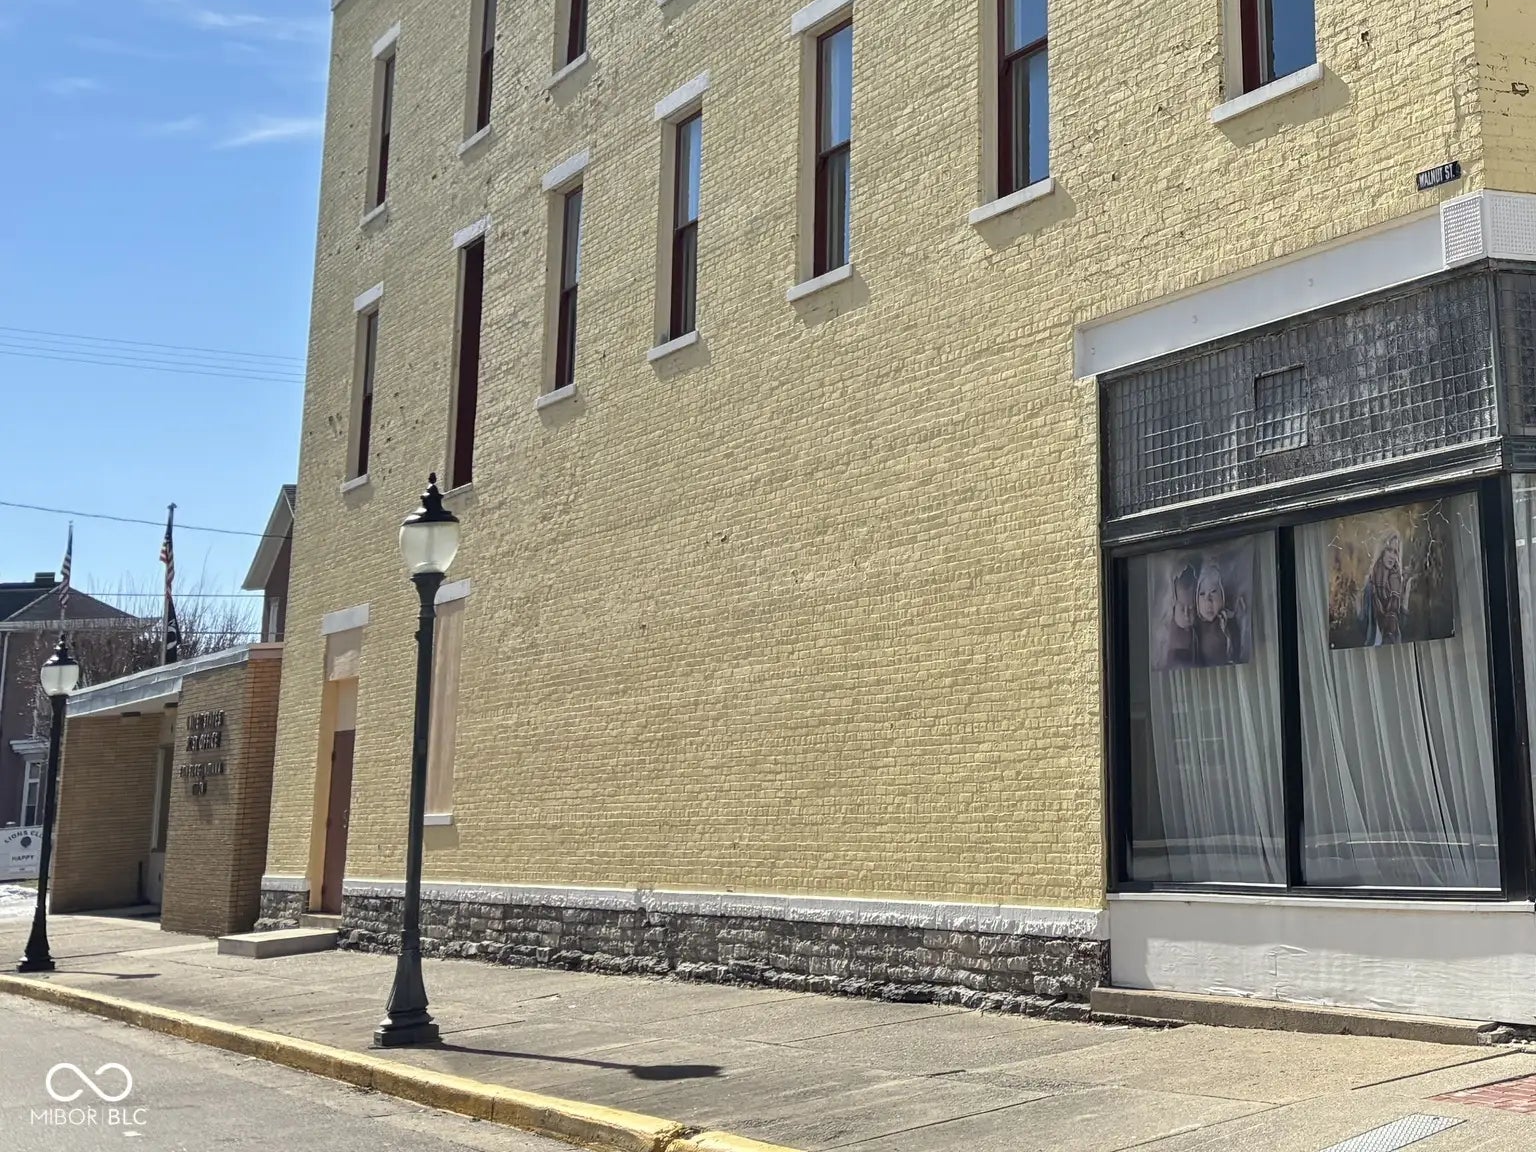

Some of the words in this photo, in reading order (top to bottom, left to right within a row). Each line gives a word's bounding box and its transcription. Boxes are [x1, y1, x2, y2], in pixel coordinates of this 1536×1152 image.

[1420, 168, 1443, 187] WALNUT
[1445, 164, 1455, 180] ST.
[4, 830, 28, 844] LIONS
